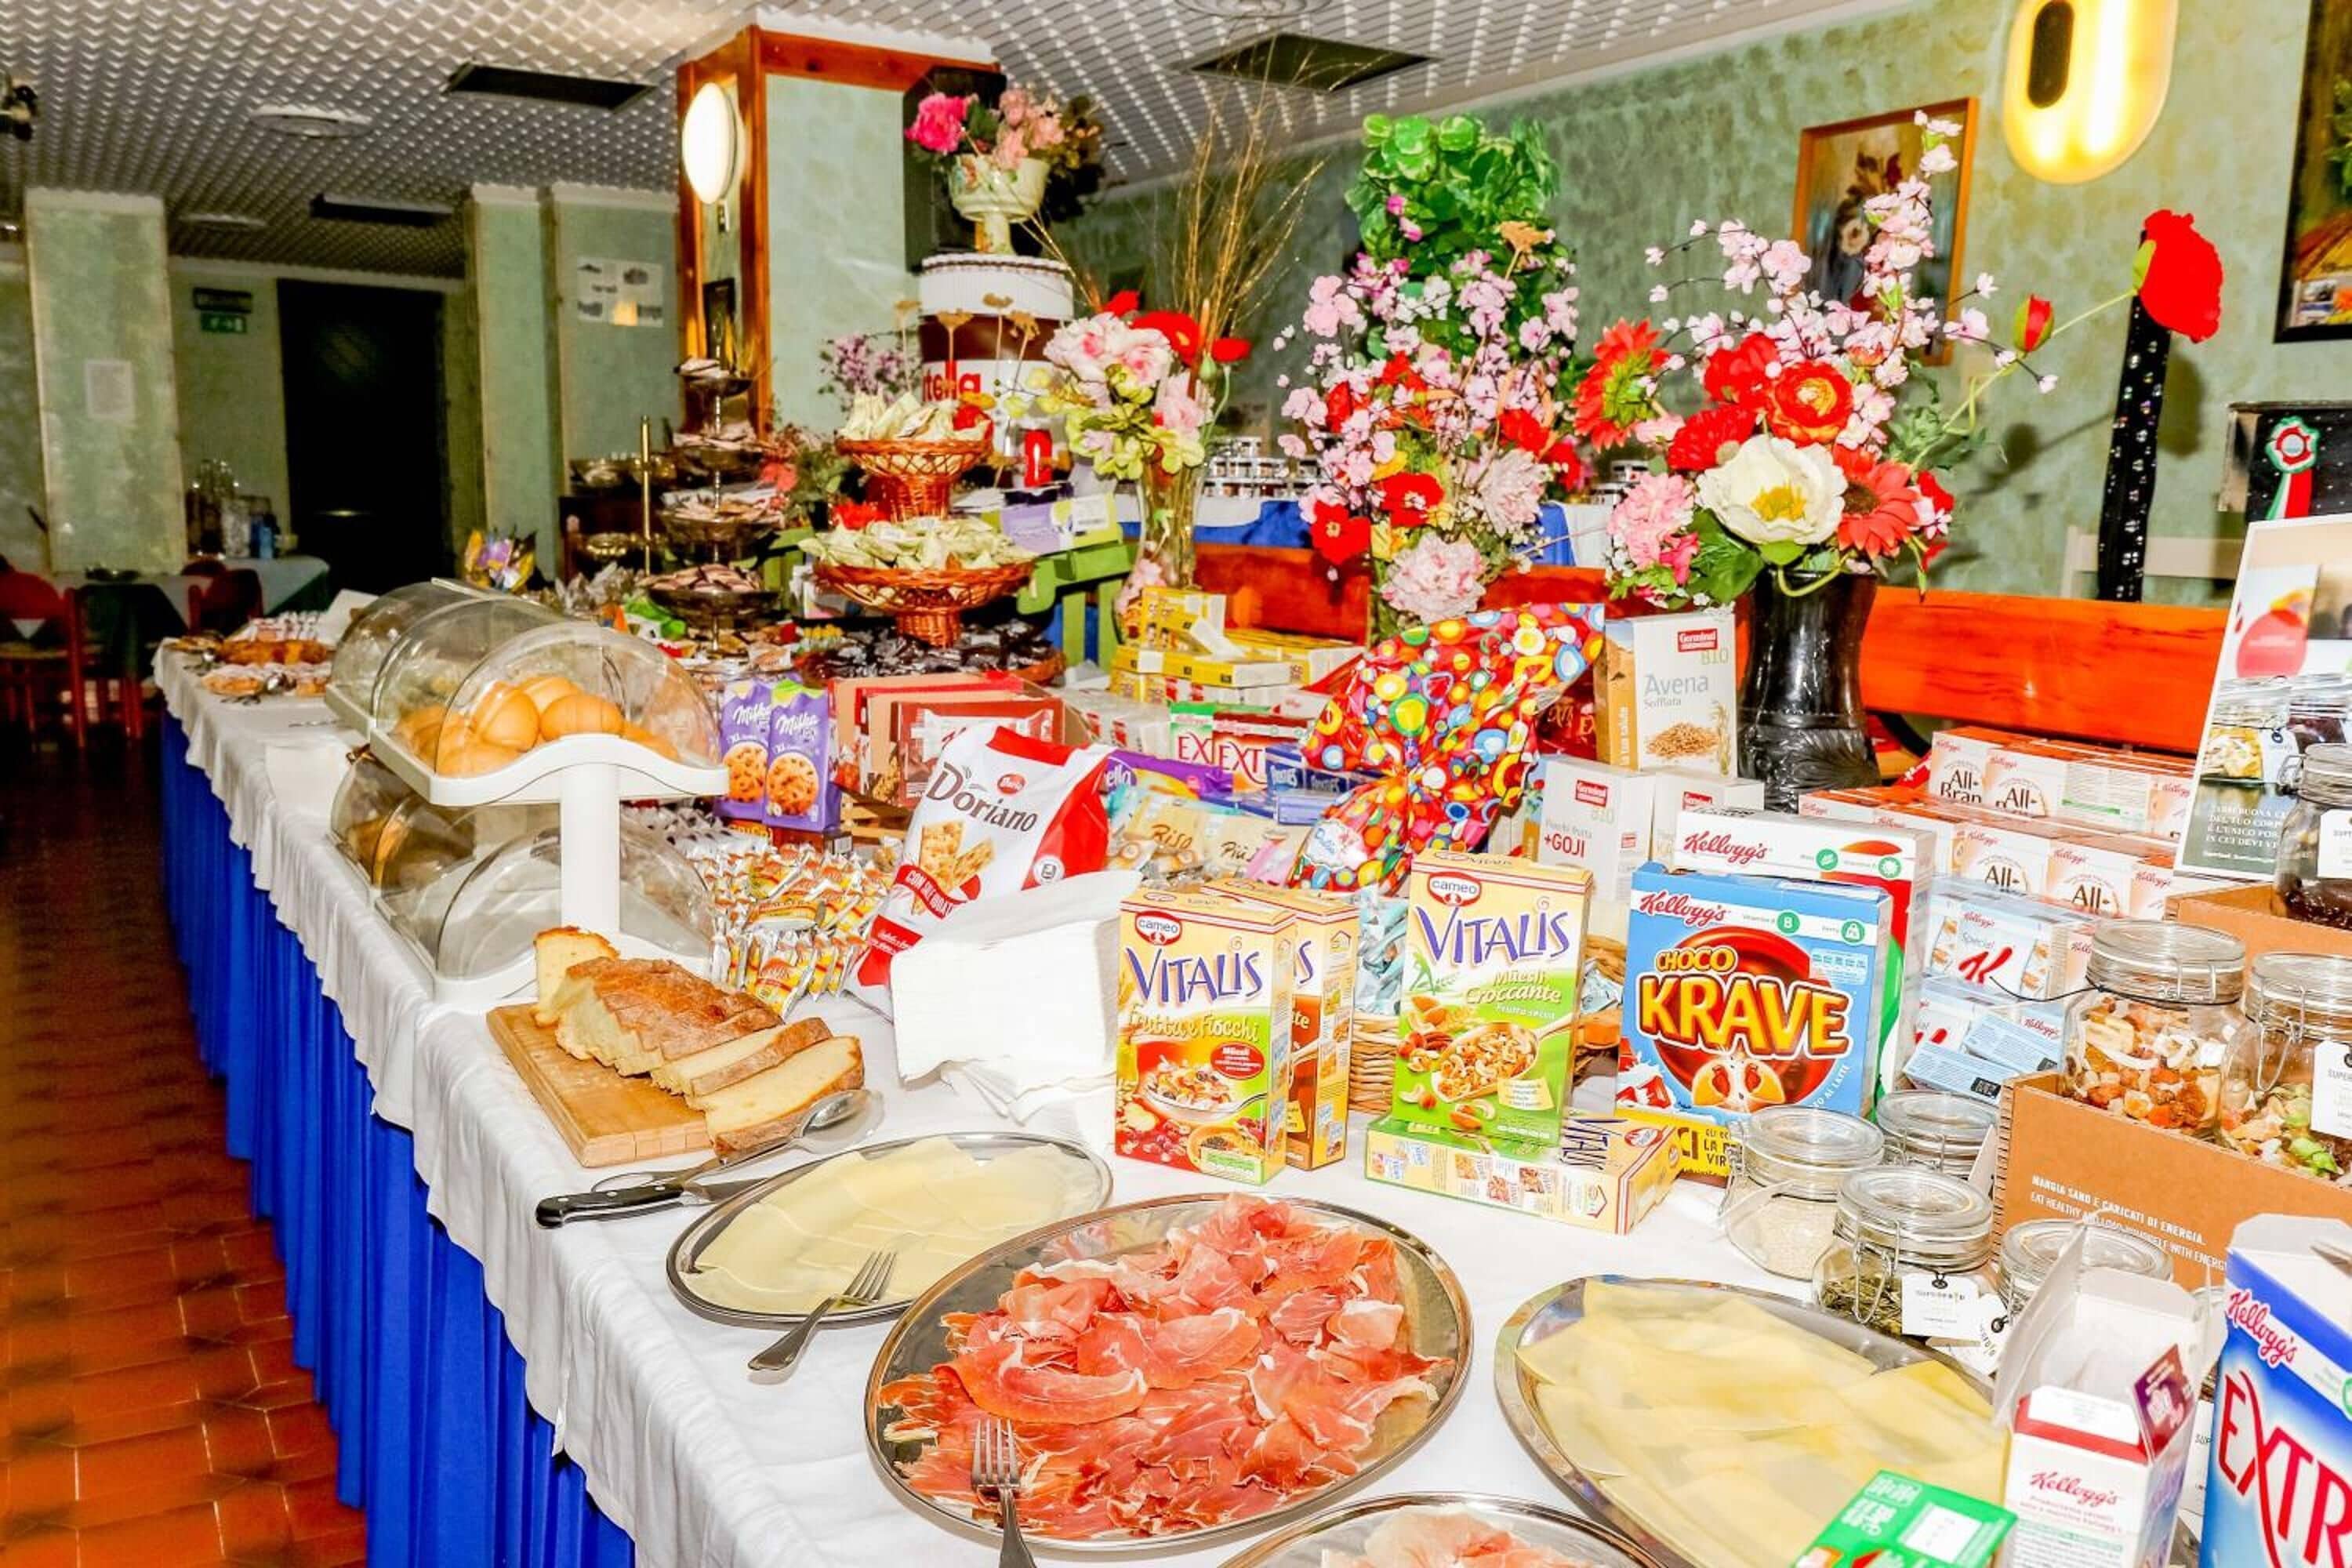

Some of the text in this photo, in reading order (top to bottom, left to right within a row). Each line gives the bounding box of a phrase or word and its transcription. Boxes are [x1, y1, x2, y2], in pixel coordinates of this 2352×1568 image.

[1645, 674, 1709, 695] Avena
[733, 702, 772, 726] Milka
[775, 713, 819, 735] Milka
[1940, 782, 1983, 804] Bran
[1950, 768, 1980, 790] All-
[926, 761, 1038, 832] Doriano
[2005, 786, 2037, 808] All-
[1544, 833, 1585, 858] +GOJI
[1684, 831, 1769, 864] Kellogg's
[1432, 879, 1478, 895] cameo
[1984, 865, 2020, 887] All-
[1639, 890, 1730, 927] Kellogg's
[2071, 884, 2111, 914] All-
[1138, 917, 1178, 935] cameo
[1415, 905, 1570, 965] VITALIS
[1126, 946, 1264, 1004] VITALIS
[1657, 949, 1736, 972] CHOCO
[1958, 946, 2013, 985] K
[1466, 985, 1563, 1004] Croccante
[1128, 1008, 1185, 1038] Frutta
[1200, 1016, 1260, 1041] Fiocchi
[1640, 975, 1850, 1055] KRAVE
[2031, 1191, 2045, 1205] EAT
[2046, 1197, 2082, 1218] HEALTHY
[2169, 1243, 2192, 1258] WITH
[2032, 1175, 2067, 1196] MANGIA
[2067, 1188, 2092, 1204] SANO
[2101, 1200, 2145, 1223] CARICATI
[2147, 1217, 2158, 1229] DI
[2161, 1221, 2207, 1247] ENERGIA.
[2228, 1290, 2298, 1365] Kellogg's
[2218, 1368, 2352, 1568] EXTR
[2030, 1471, 2122, 1508] Kellogg's
